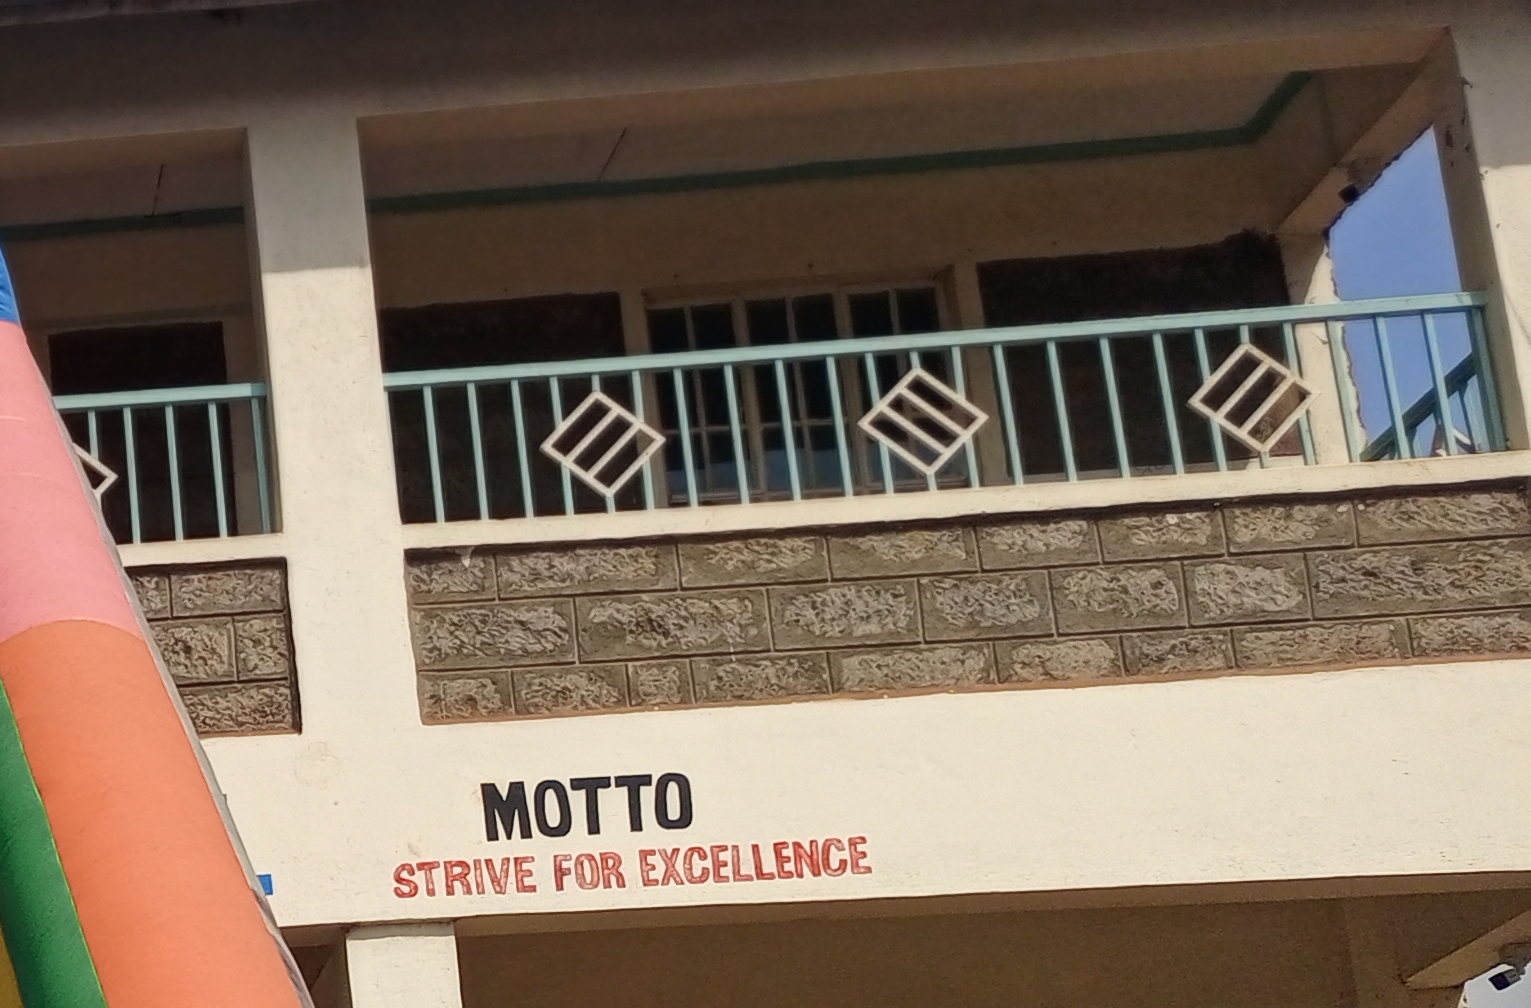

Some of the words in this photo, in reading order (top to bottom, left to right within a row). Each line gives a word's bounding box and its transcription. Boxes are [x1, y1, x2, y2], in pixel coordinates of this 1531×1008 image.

[480, 772, 693, 841] MOTTO
[393, 856, 537, 898] STRIVE
[553, 852, 627, 891] FOR
[639, 837, 873, 887] EXCELLENCE
